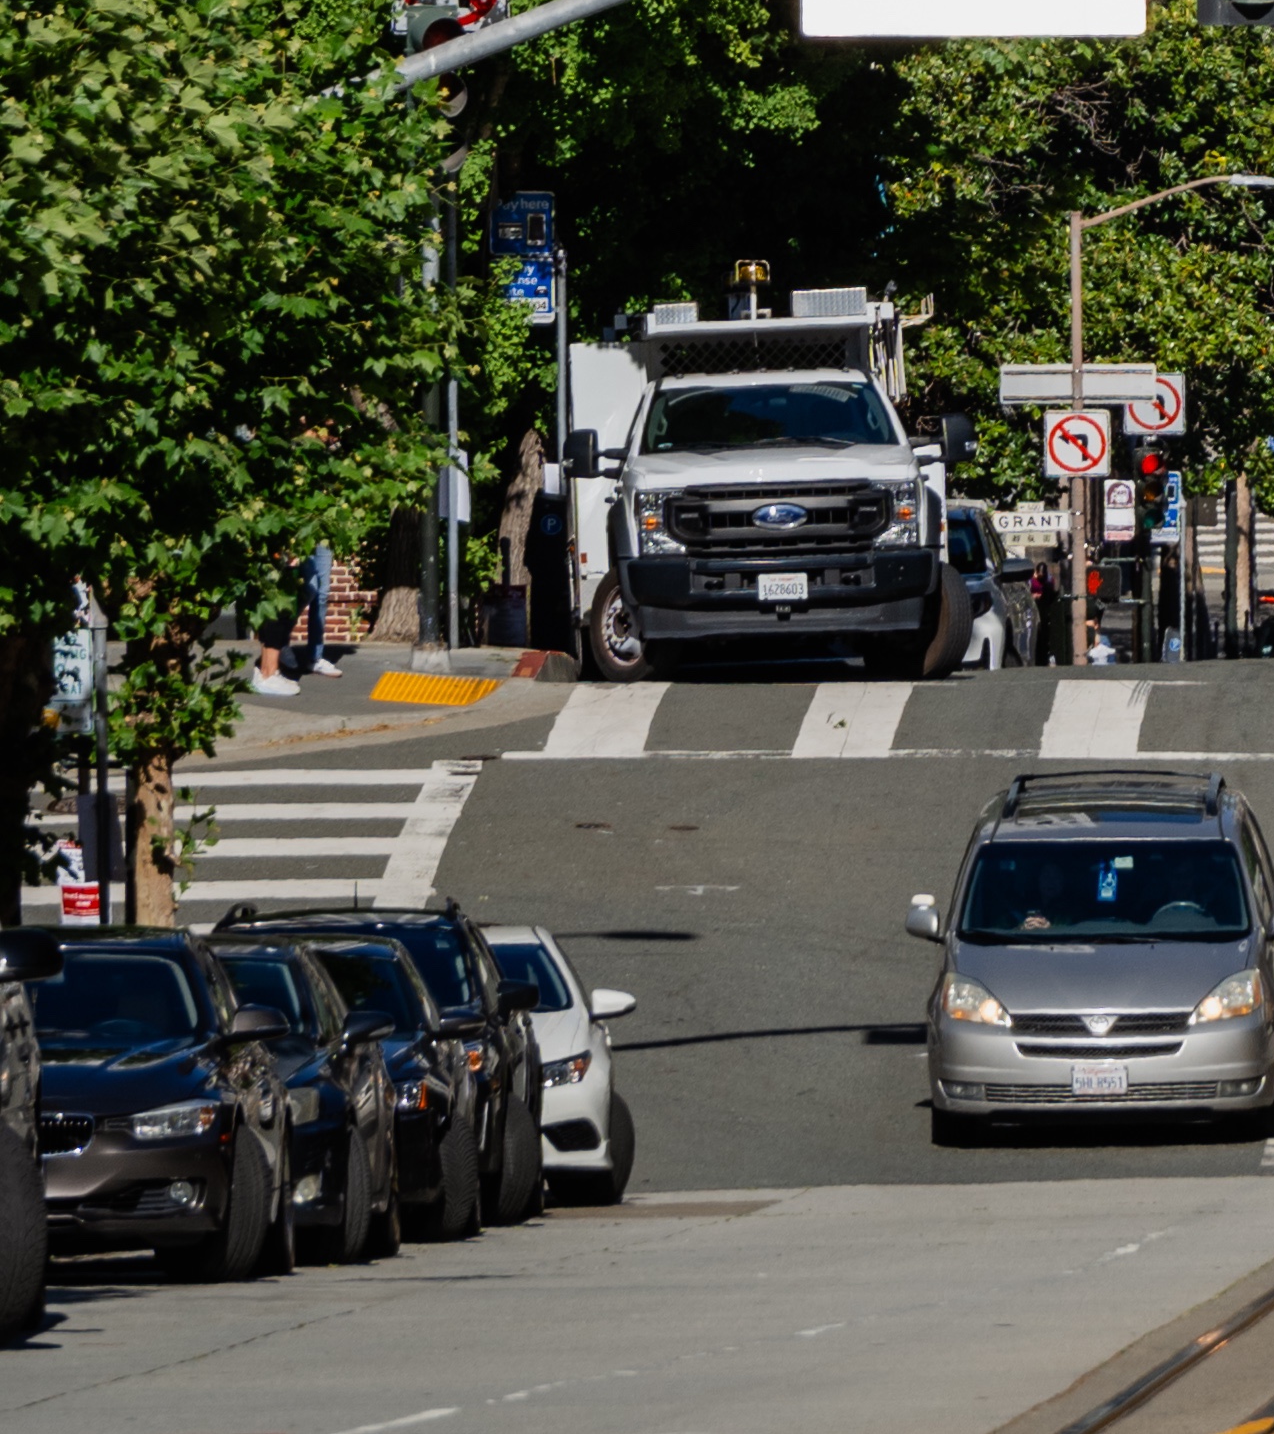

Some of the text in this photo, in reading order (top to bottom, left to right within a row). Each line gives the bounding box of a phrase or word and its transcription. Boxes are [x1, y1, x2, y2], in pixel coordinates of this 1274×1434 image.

[521, 198, 549, 210] here
[999, 515, 1063, 529] GRANT
[763, 583, 804, 596] 1628603
